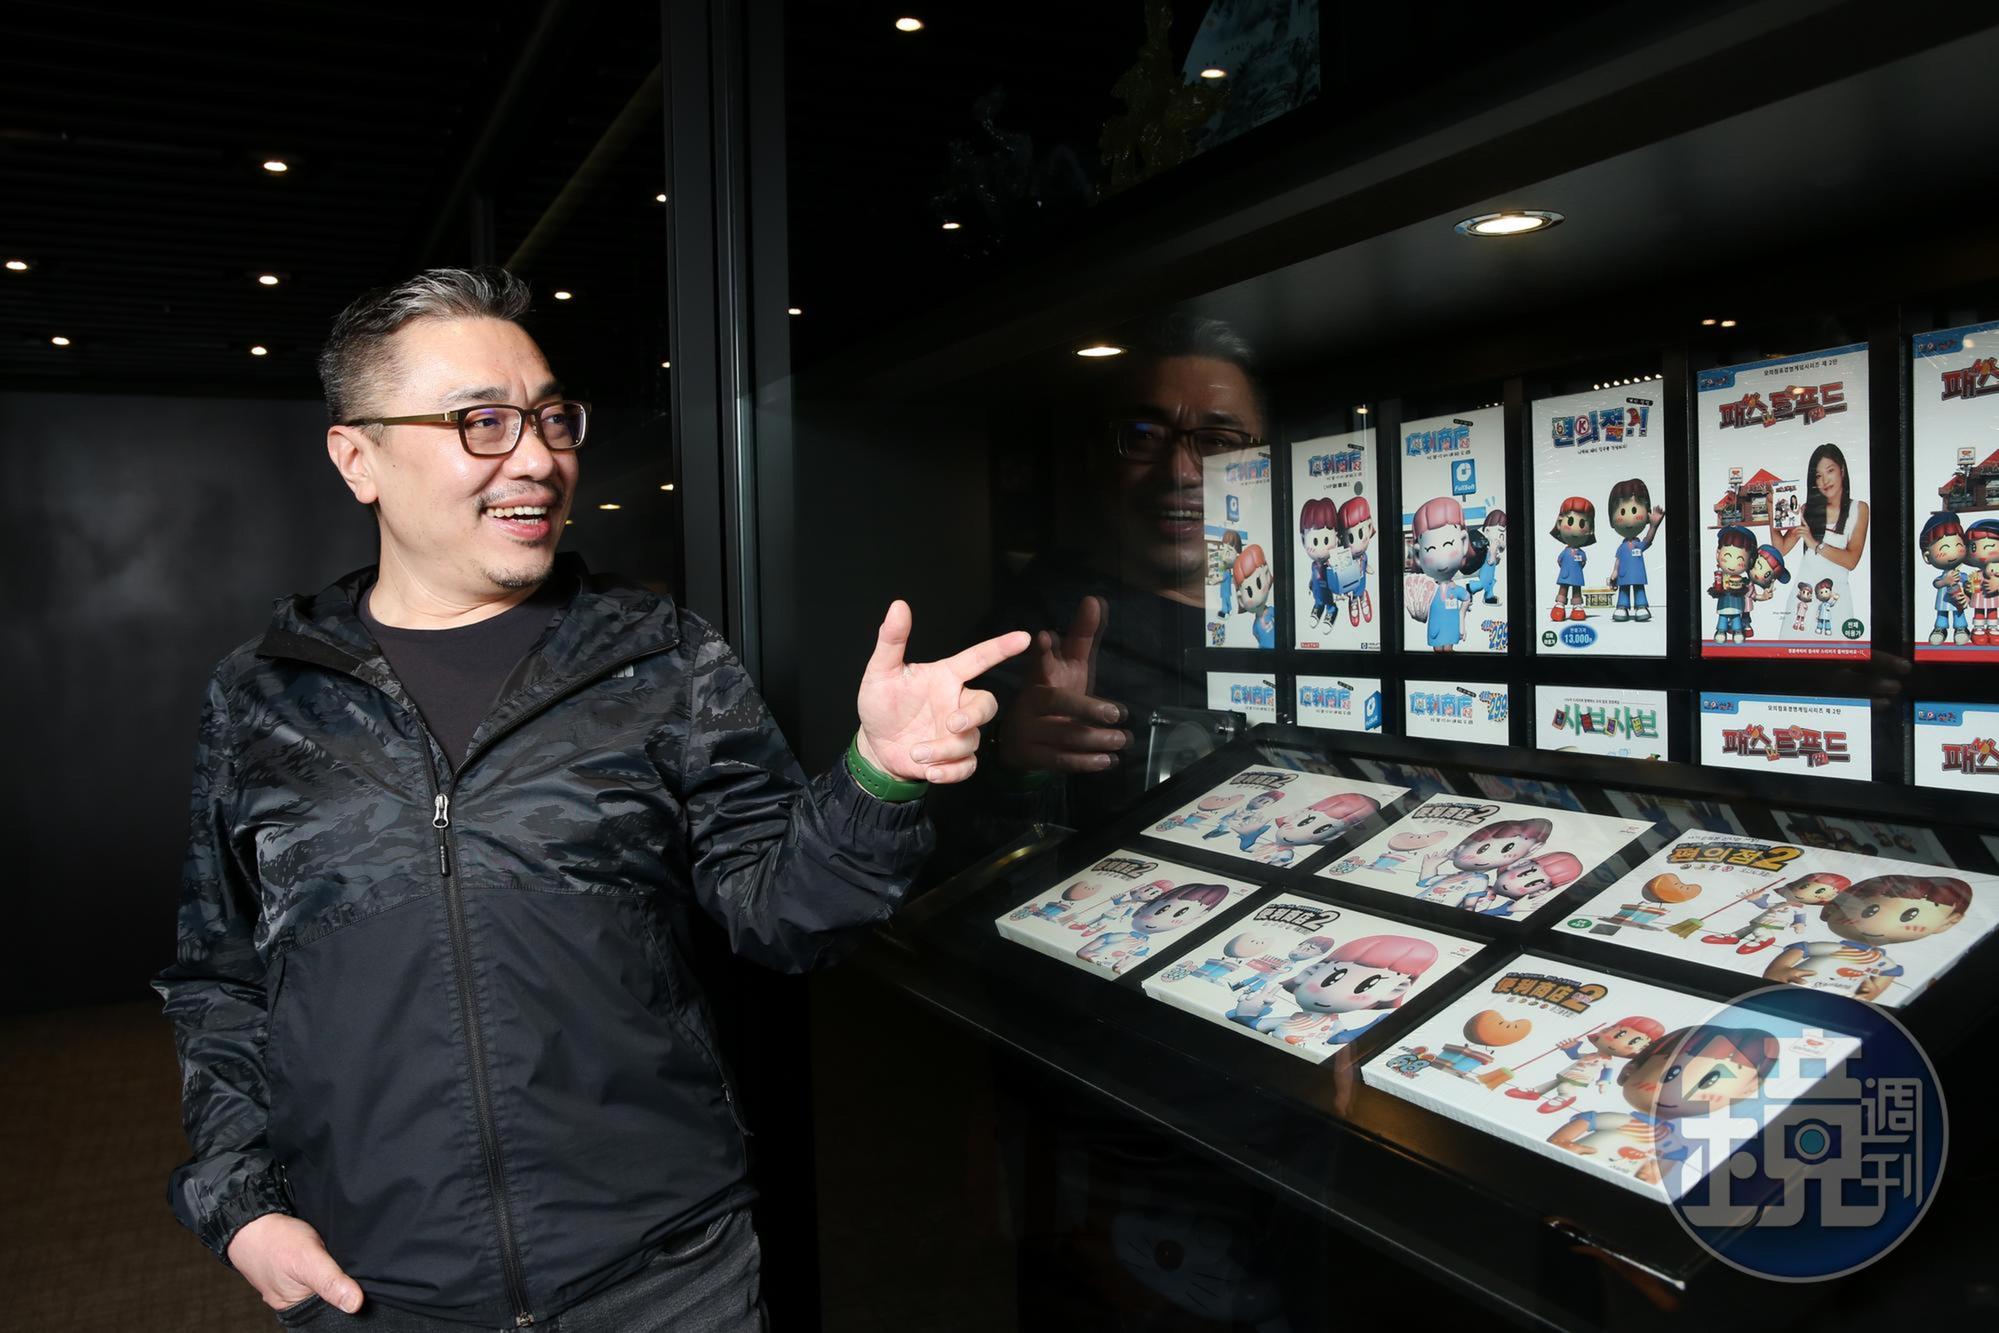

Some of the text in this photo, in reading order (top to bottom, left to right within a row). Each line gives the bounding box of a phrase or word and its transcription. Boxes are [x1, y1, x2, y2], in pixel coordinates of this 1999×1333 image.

[1719, 381, 1848, 430] 패스트푸드
[1722, 724, 1851, 768] 패스트푸드
[1491, 976, 1609, 1014] 便利商店2
